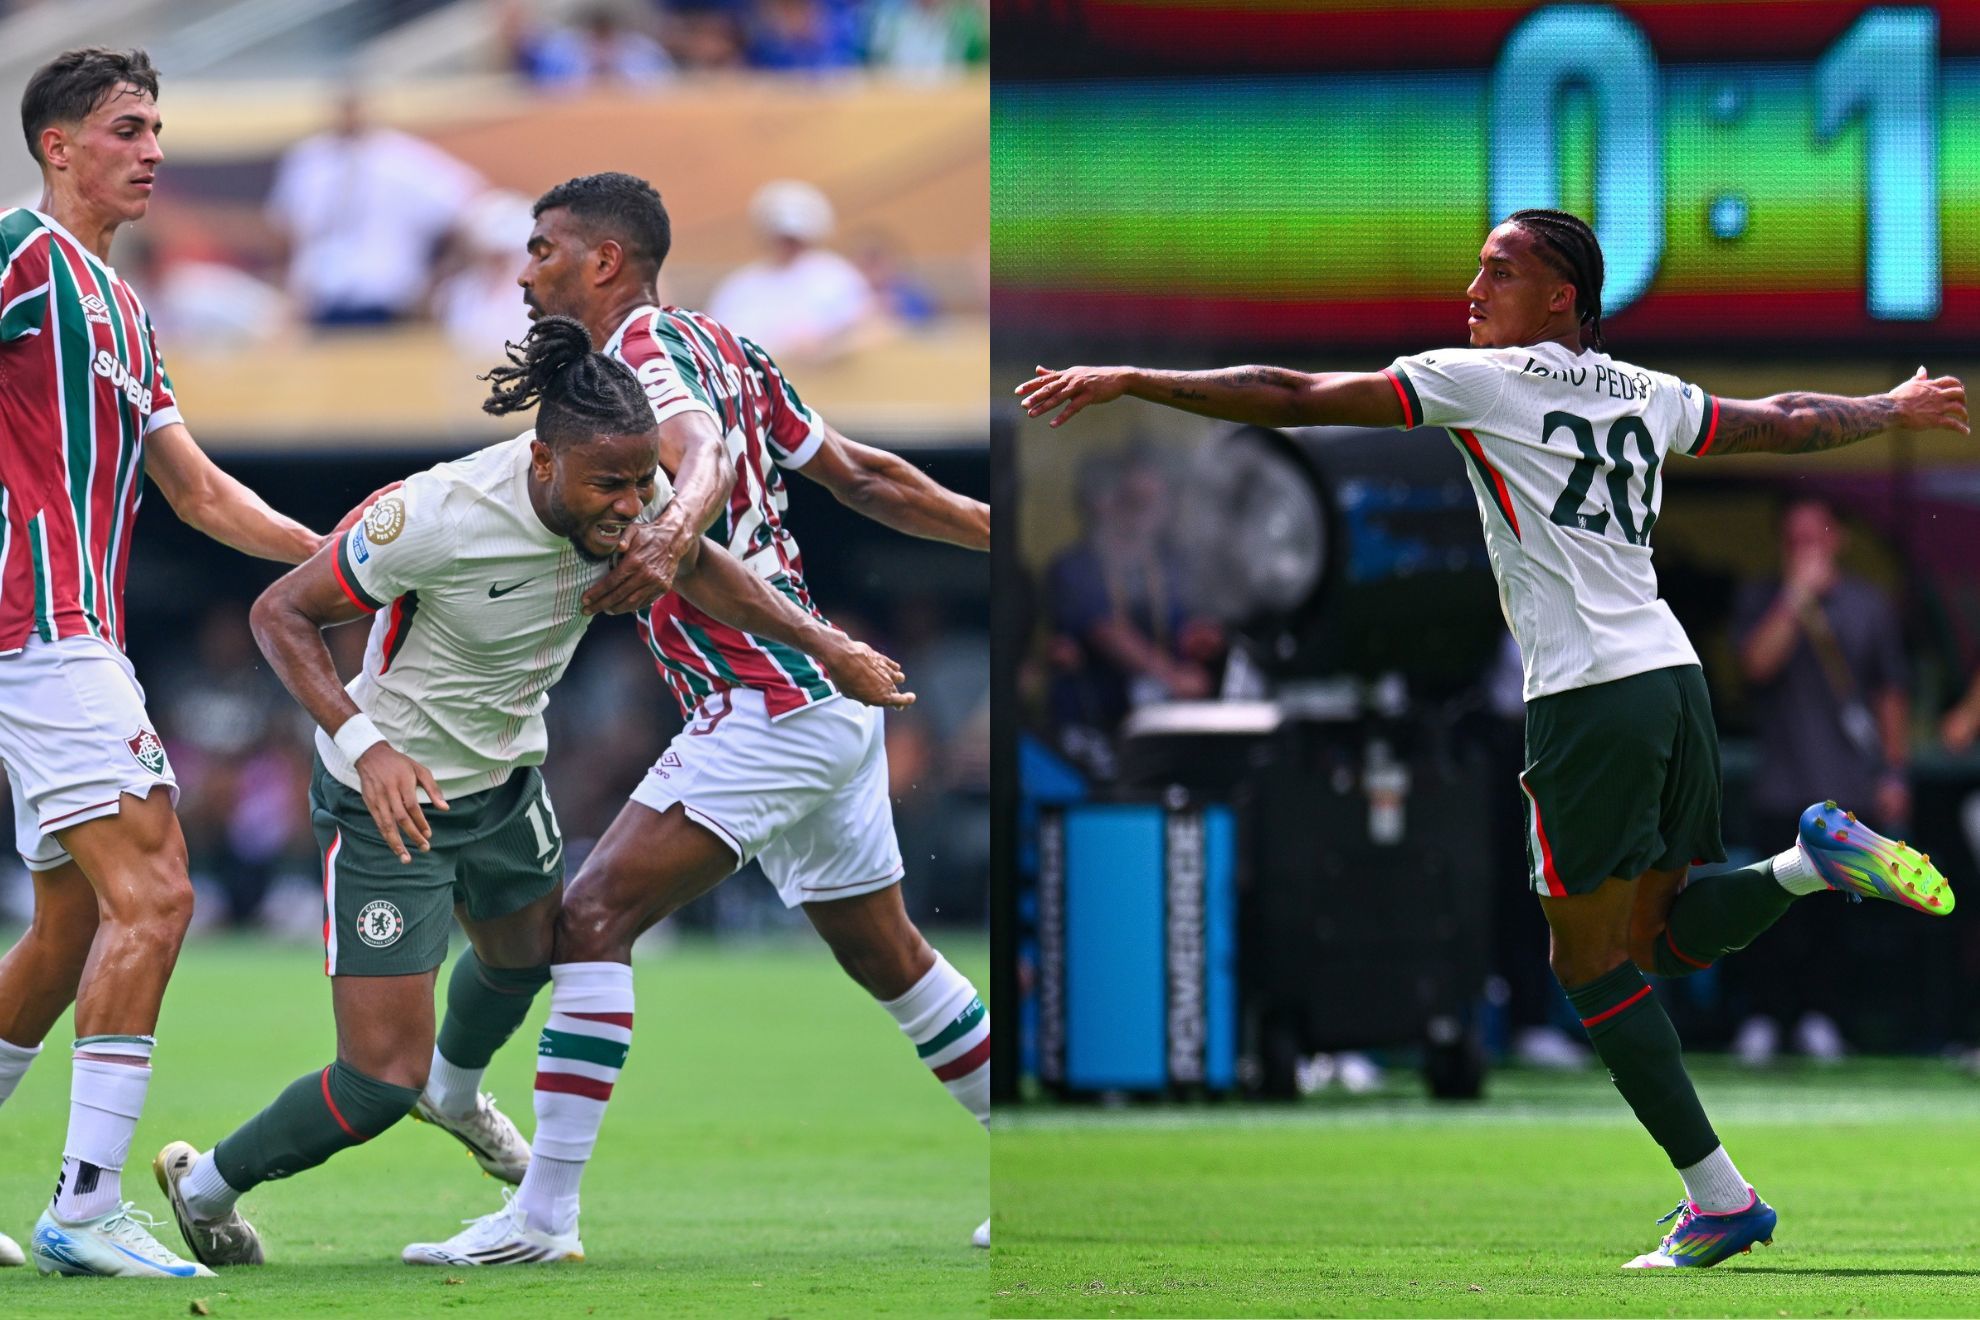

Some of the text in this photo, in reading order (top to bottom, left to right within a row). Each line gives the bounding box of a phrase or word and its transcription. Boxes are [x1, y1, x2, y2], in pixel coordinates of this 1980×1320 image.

[1489, 3, 1940, 322] 0:1
[1594, 364, 1652, 401] PED
[1541, 410, 1660, 547] 20
[364, 902, 396, 914] CHELSEA
